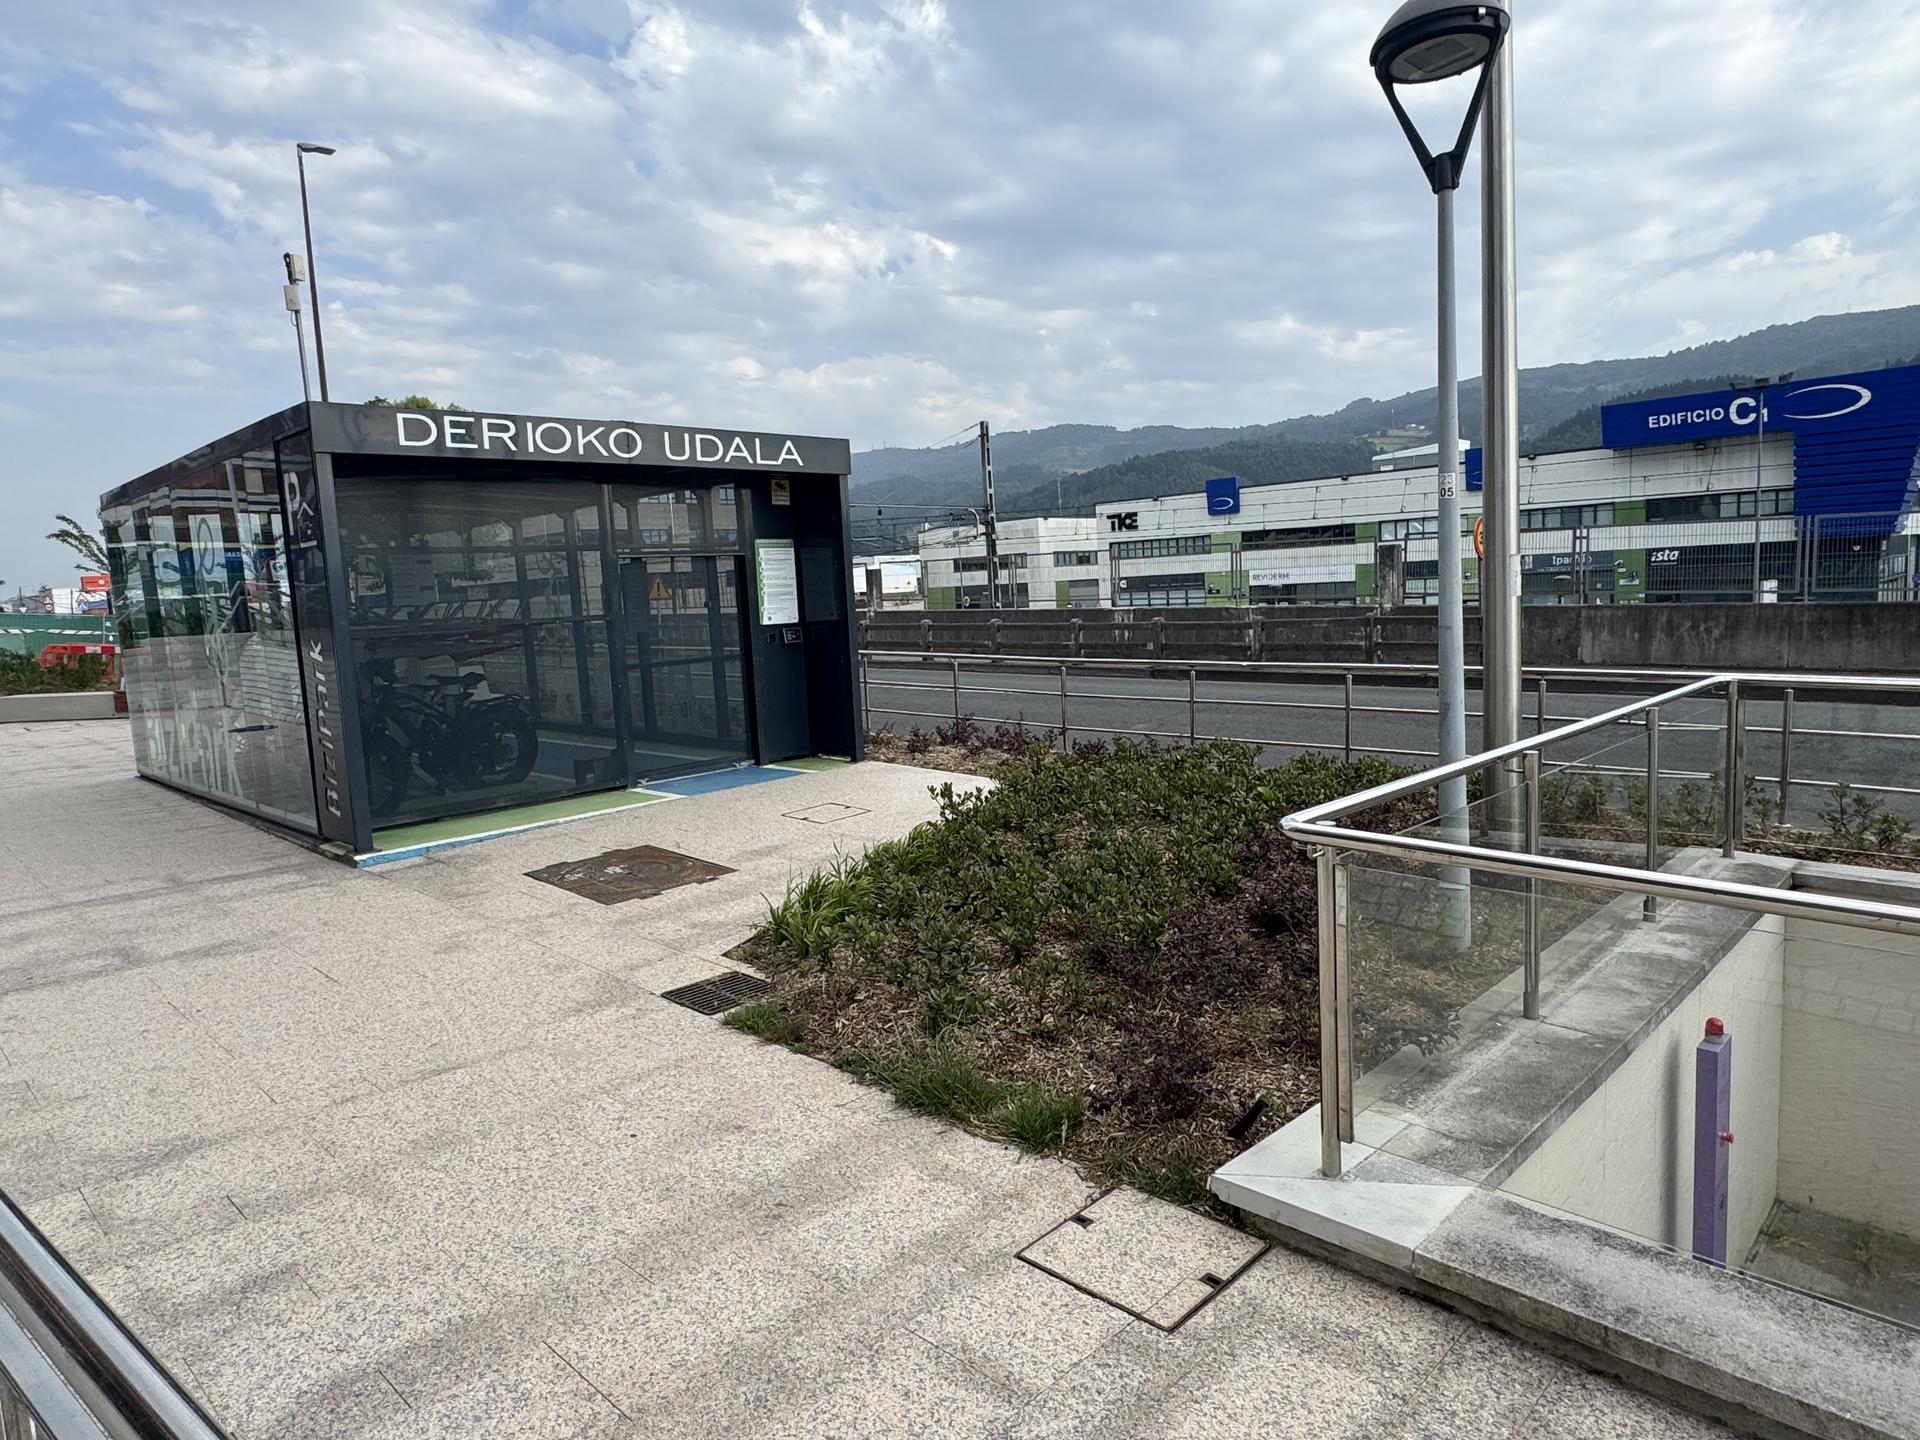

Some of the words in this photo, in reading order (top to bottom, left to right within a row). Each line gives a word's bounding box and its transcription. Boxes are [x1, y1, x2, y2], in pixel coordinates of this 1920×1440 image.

[1648, 407, 1724, 428] EDIFICIO
[396, 412, 642, 459] DERIOKO
[664, 430, 804, 467] UDALA
[1440, 474, 1454, 485] 23
[1440, 486, 1454, 498] 05
[1651, 549, 1680, 561] ista
